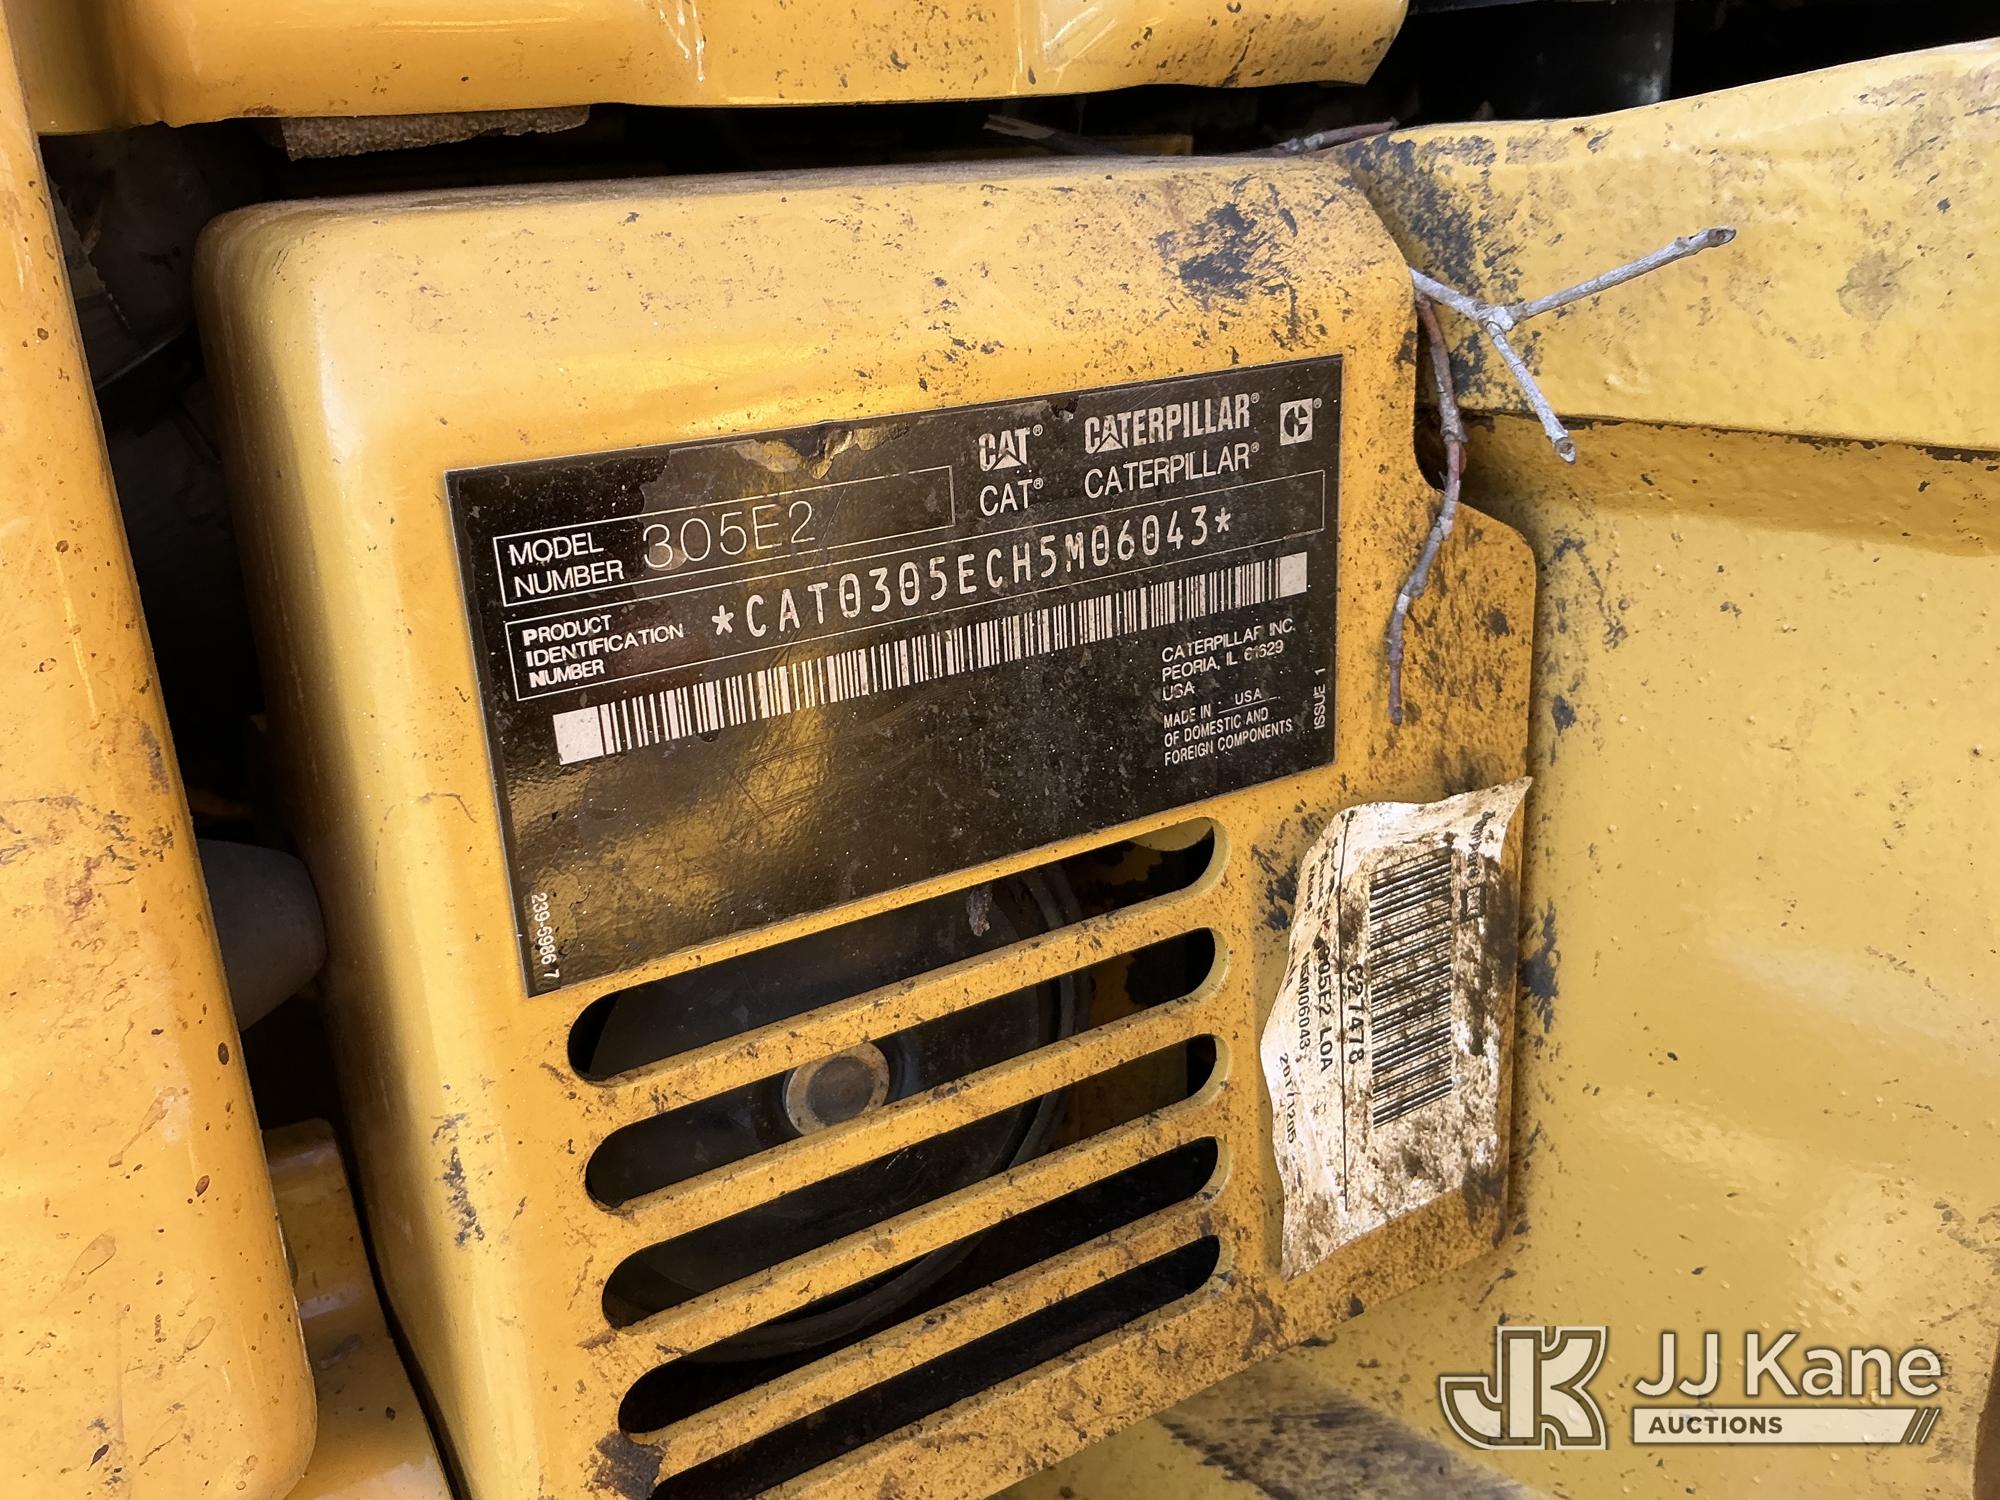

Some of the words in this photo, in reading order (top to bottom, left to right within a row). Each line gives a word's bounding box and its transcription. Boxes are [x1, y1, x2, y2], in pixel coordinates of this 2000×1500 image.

[509, 532, 604, 567] MODEL
[642, 501, 816, 571] 305E2
[514, 559, 624, 598] NUMBER
[522, 615, 612, 646] PRODUCT
[526, 623, 684, 667] IDENTIFICATION
[529, 659, 605, 688] NUMBER
[1162, 656, 1220, 682] PEORIA,
[1162, 681, 1196, 701] USA
[1164, 707, 1196, 729] MADE
[1200, 704, 1212, 718] IN
[1235, 688, 1263, 706] USA
[1313, 684, 1326, 730] ISSUE
[1164, 731, 1180, 748] OF
[1184, 714, 1242, 742] DOMESTIC
[1245, 706, 1269, 725] AND
[1164, 740, 1214, 766] FOREIGN
[1218, 718, 1293, 751] COMPONENTS
